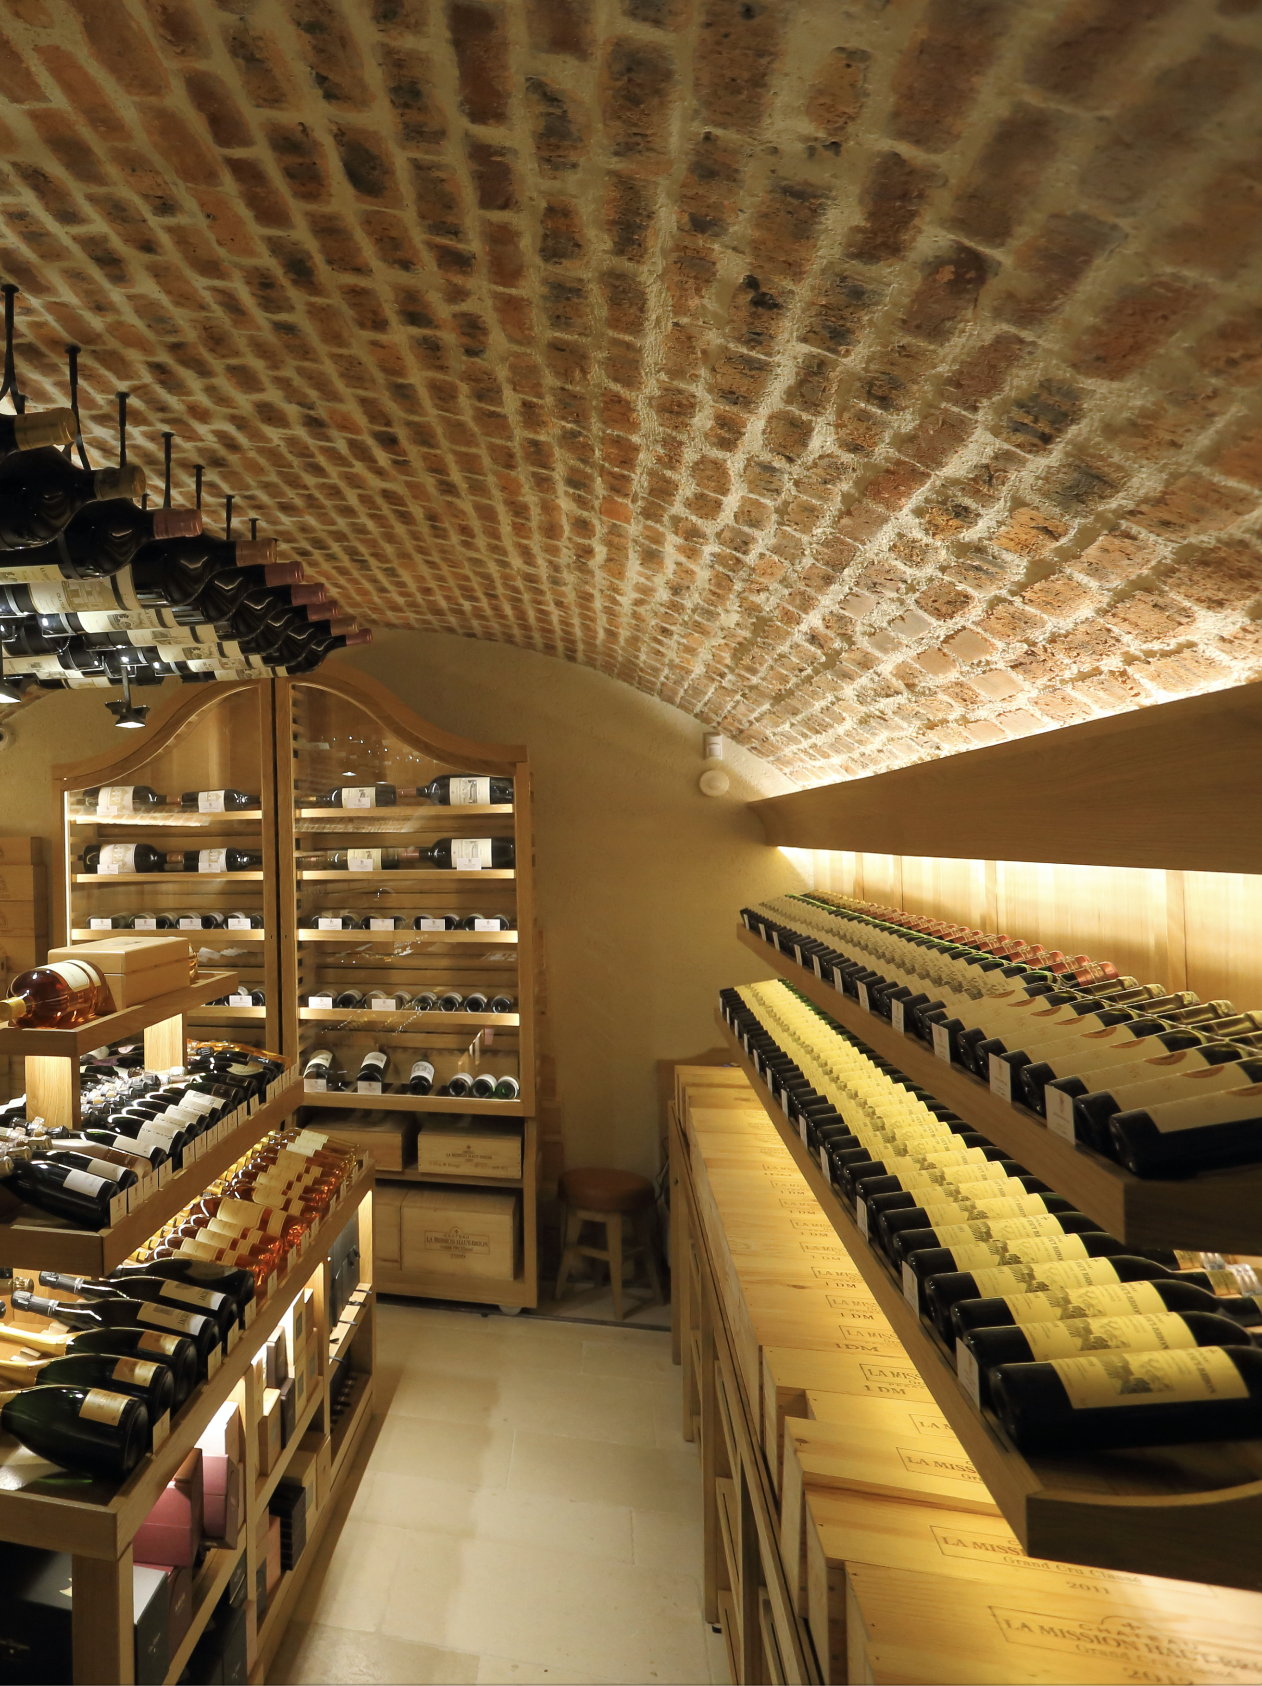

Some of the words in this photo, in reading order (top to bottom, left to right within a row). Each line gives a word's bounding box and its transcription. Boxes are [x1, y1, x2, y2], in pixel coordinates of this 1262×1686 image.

[867, 1368, 889, 1378] LA
[878, 1386, 906, 1395] DM
[906, 1456, 931, 1467] LA
[941, 1535, 968, 1549] LA
[1002, 1555, 1050, 1570] Grand
[1056, 1563, 1084, 1576] Cru
[1065, 1580, 1111, 1595] 2011
[1002, 1618, 1035, 1633] LA
[1038, 1624, 1140, 1652] MISSION
